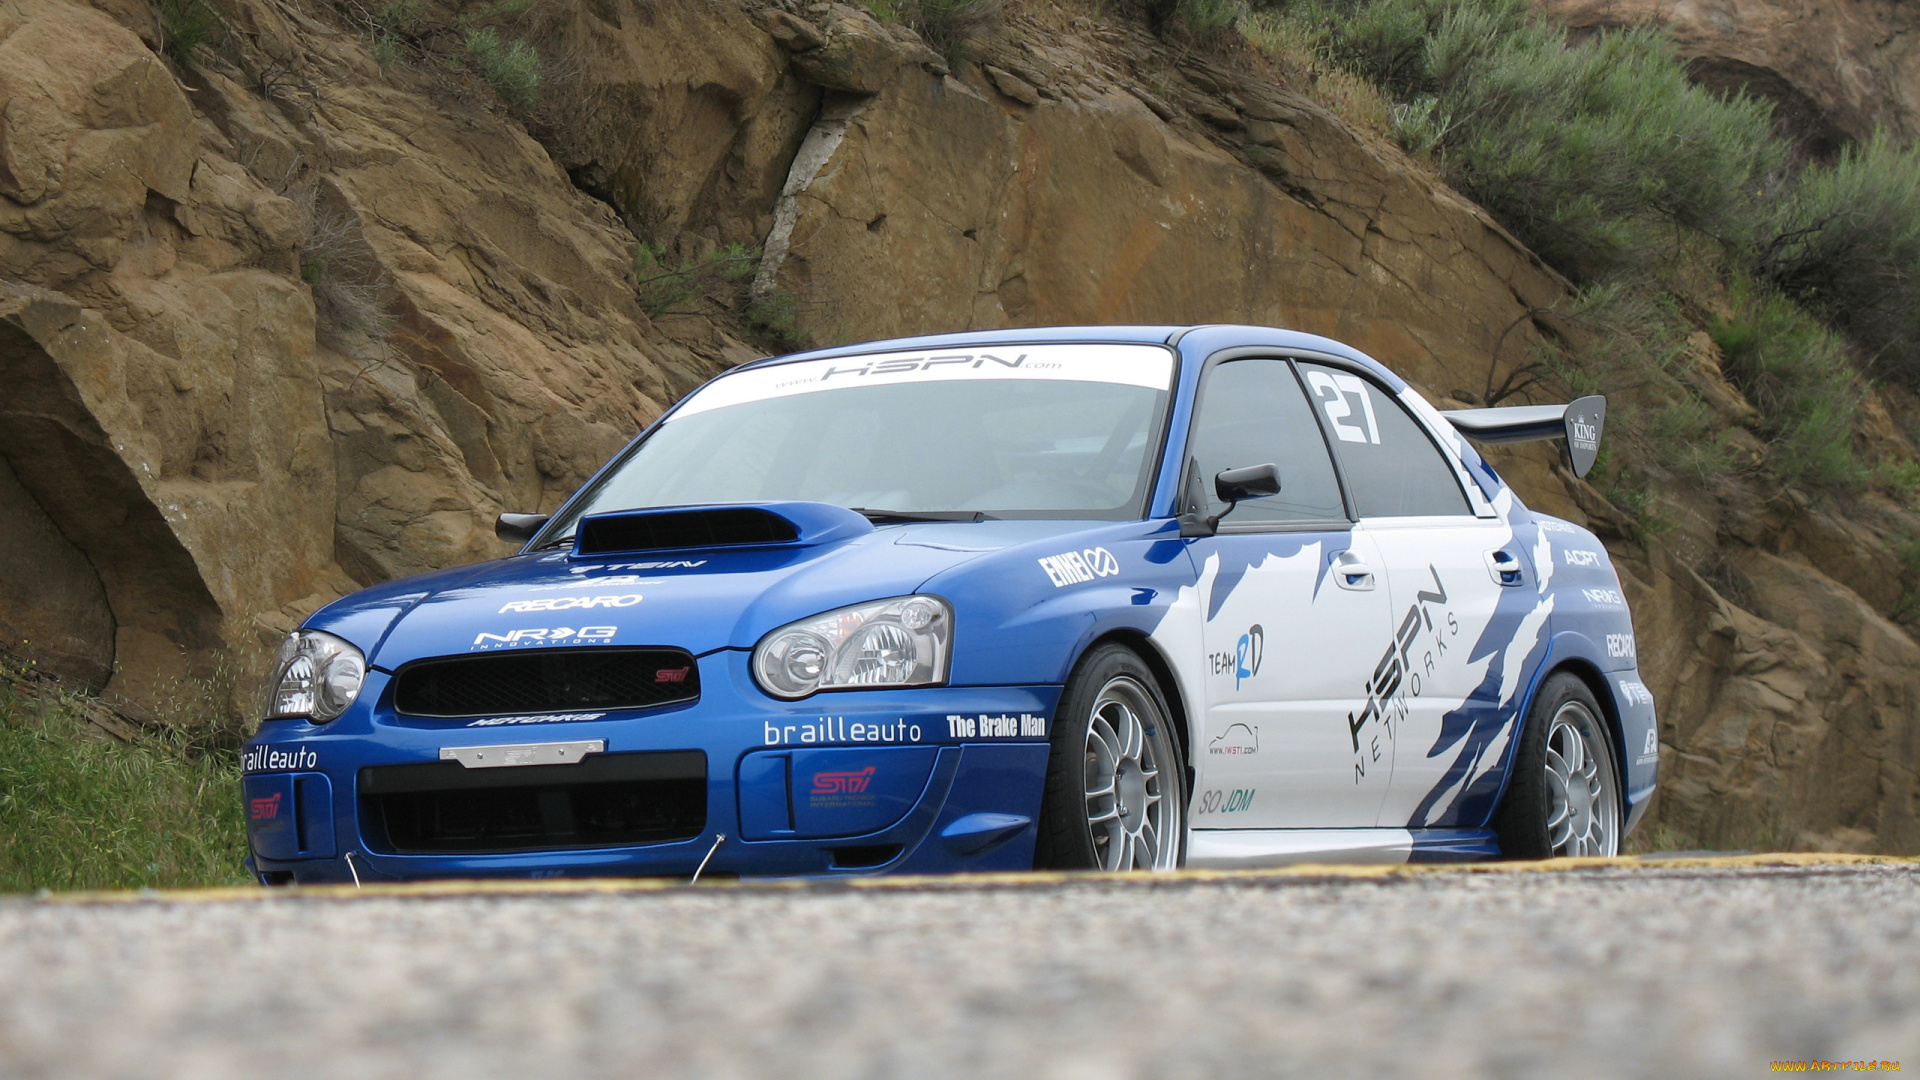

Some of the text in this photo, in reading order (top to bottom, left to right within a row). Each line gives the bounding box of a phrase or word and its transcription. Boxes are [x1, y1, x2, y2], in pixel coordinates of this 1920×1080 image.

[1307, 371, 1381, 445] 27
[1574, 423, 1596, 441] KING
[1037, 550, 1096, 588] ENKEI
[1563, 549, 1600, 567] ACPT
[498, 594, 643, 614] RECARO
[470, 638, 612, 651] INNOVATIONS
[1209, 652, 1235, 677] TEAM
[1355, 611, 1459, 785] NETWORKS
[763, 716, 922, 746] brailleauto
[946, 713, 1046, 738] The Brake Man
[1199, 789, 1256, 815] SO JDM
